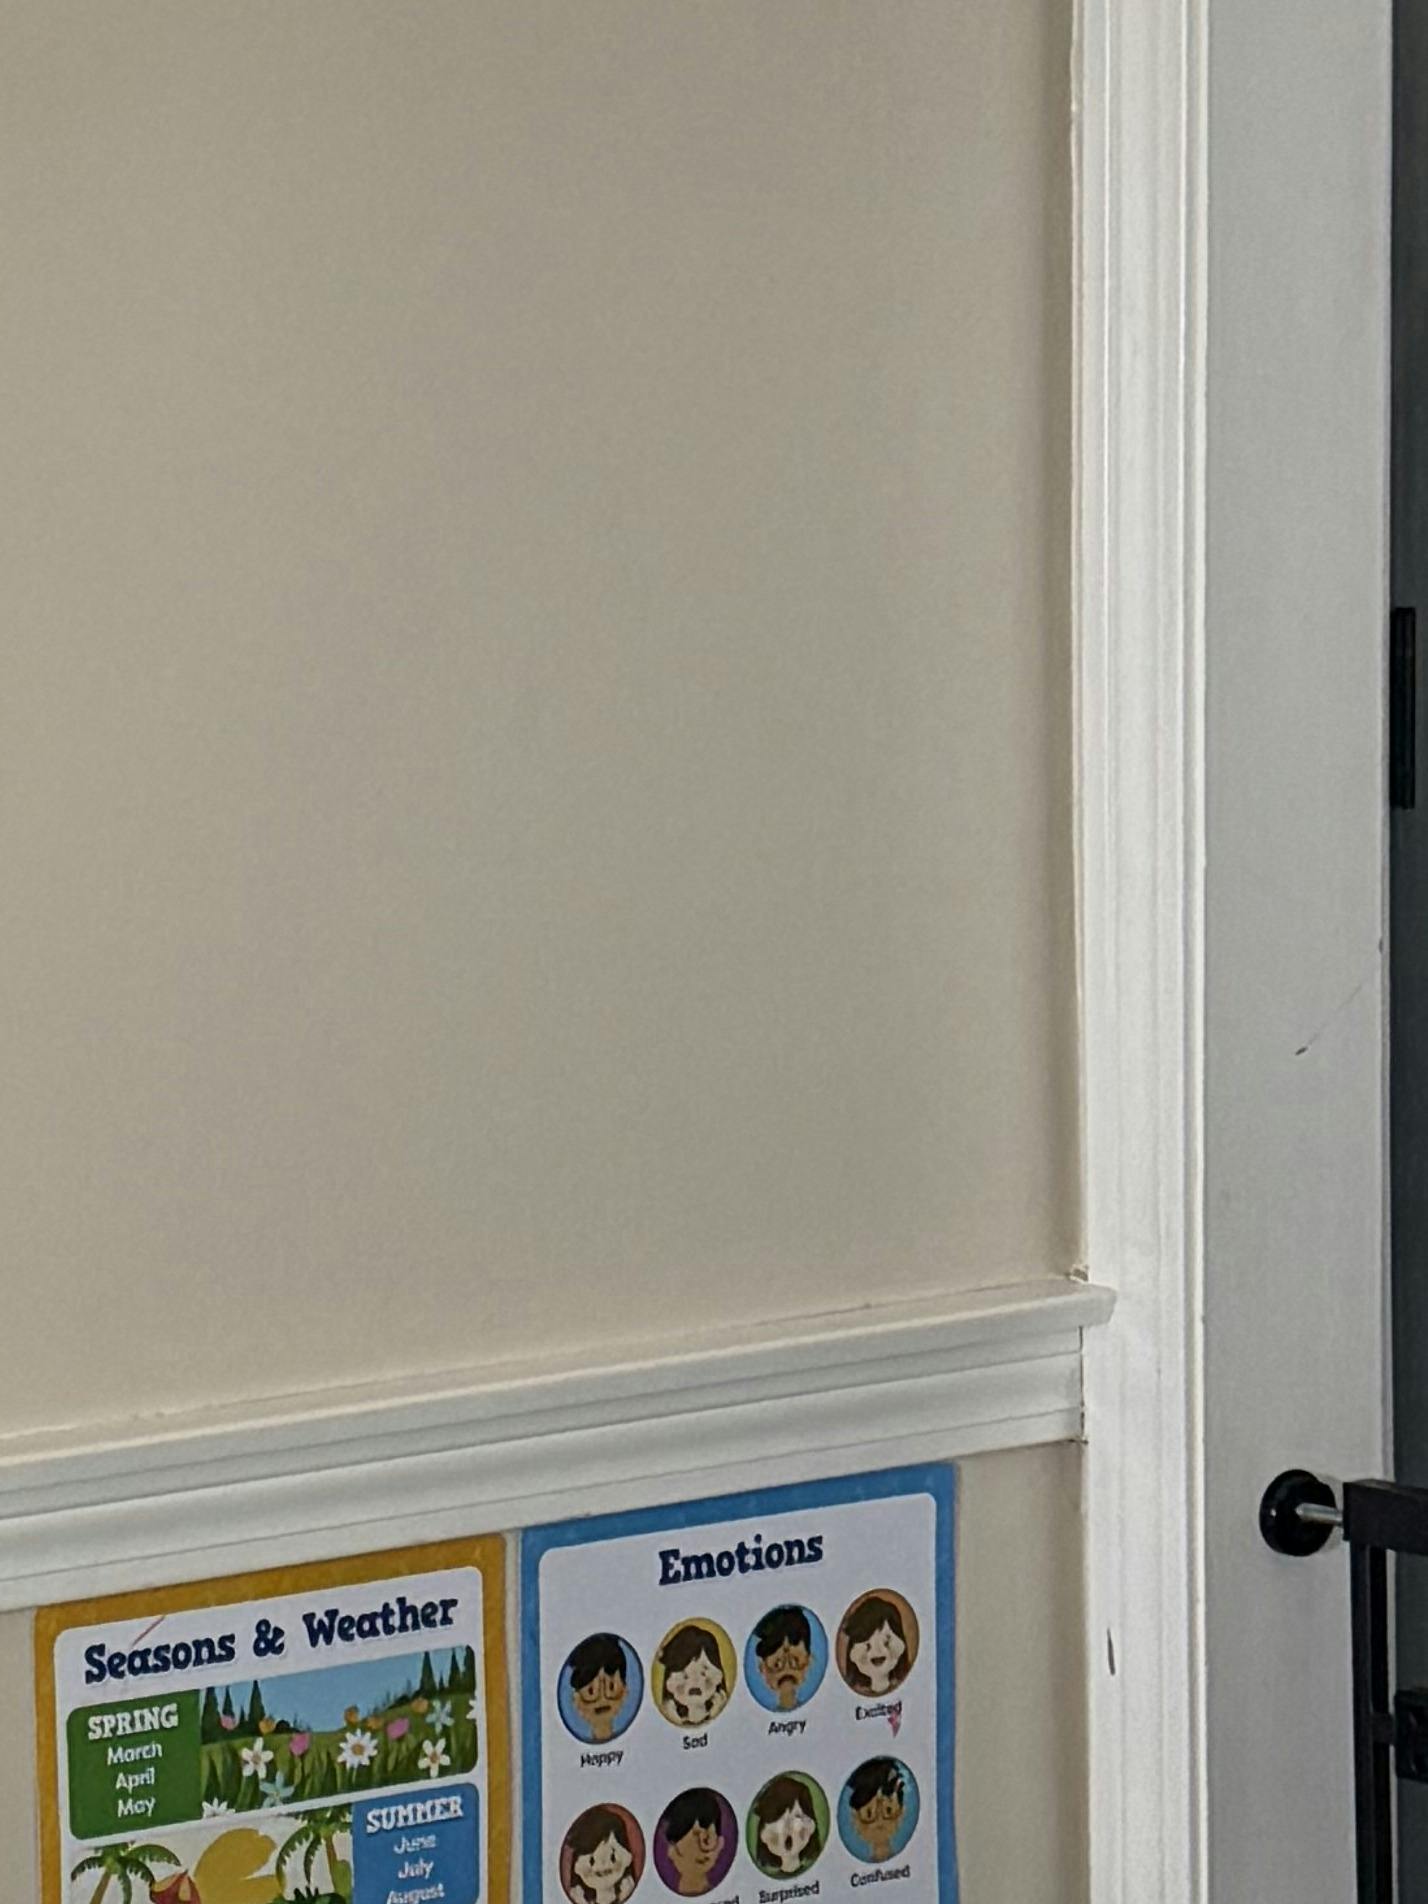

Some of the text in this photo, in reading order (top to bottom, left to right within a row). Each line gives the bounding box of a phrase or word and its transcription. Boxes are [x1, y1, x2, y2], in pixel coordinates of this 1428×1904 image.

[658, 1533, 824, 1585] Emotions
[84, 1596, 458, 1684] Seasons & Weather
[88, 1703, 179, 1740] SPRING
[855, 1701, 902, 1720] Excited
[768, 1720, 806, 1736] Angry
[683, 1734, 708, 1749] Sad
[106, 1743, 163, 1767] March
[580, 1751, 623, 1767] Happy
[115, 1767, 156, 1791] April
[117, 1797, 156, 1818] May
[366, 1796, 464, 1833] SUMMER
[394, 1834, 437, 1855] June
[398, 1860, 434, 1882] July
[850, 1865, 910, 1887] Confused
[759, 1881, 820, 1904] Surprised
